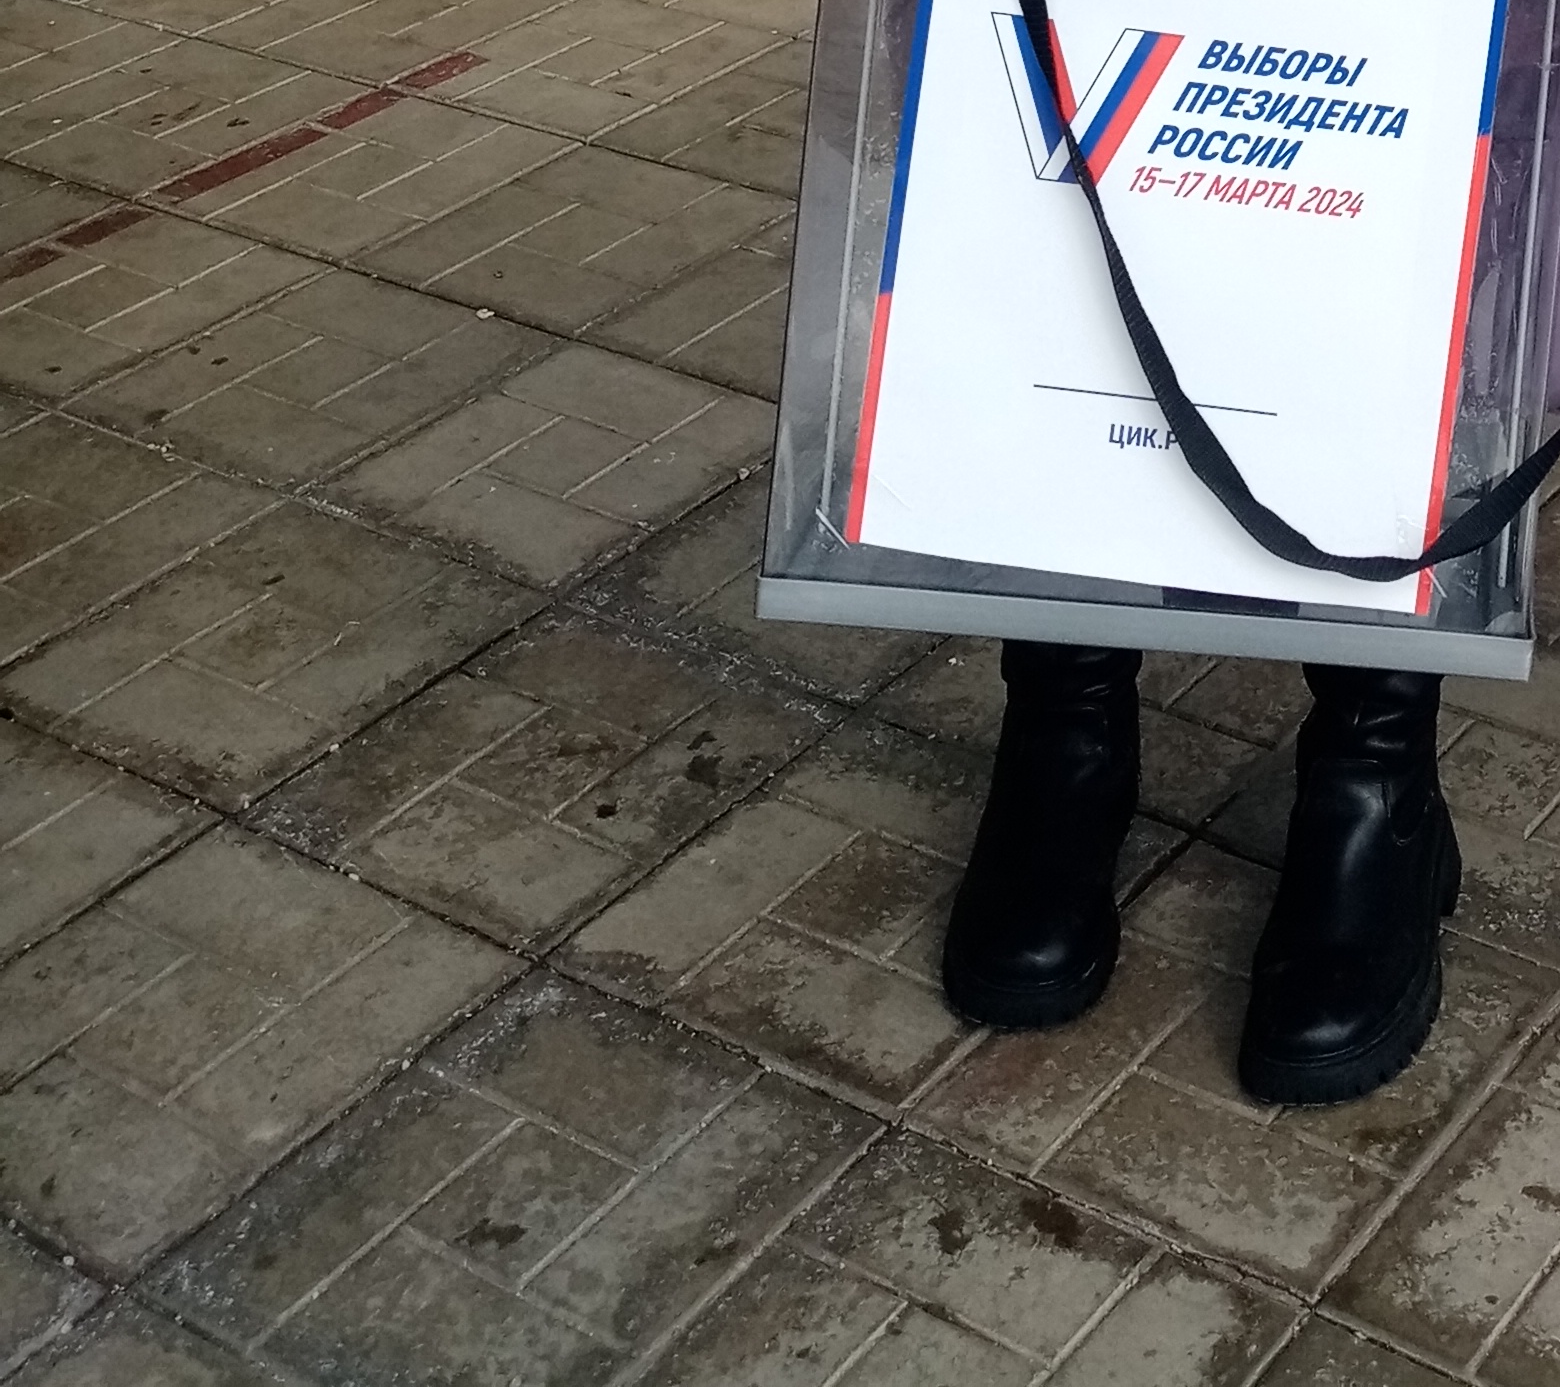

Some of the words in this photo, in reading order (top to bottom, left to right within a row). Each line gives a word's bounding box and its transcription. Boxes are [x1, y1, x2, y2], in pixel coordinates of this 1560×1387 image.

[1198, 40, 1368, 86] ВЫБОРЫ
[1173, 82, 1409, 138] ПРЕЗИДЕНТА
[1148, 125, 1303, 170] РОССИИ
[1204, 175, 1296, 210] МАРТА
[1297, 187, 1363, 218] 2024
[1108, 423, 1180, 450] ЦИК.Р
